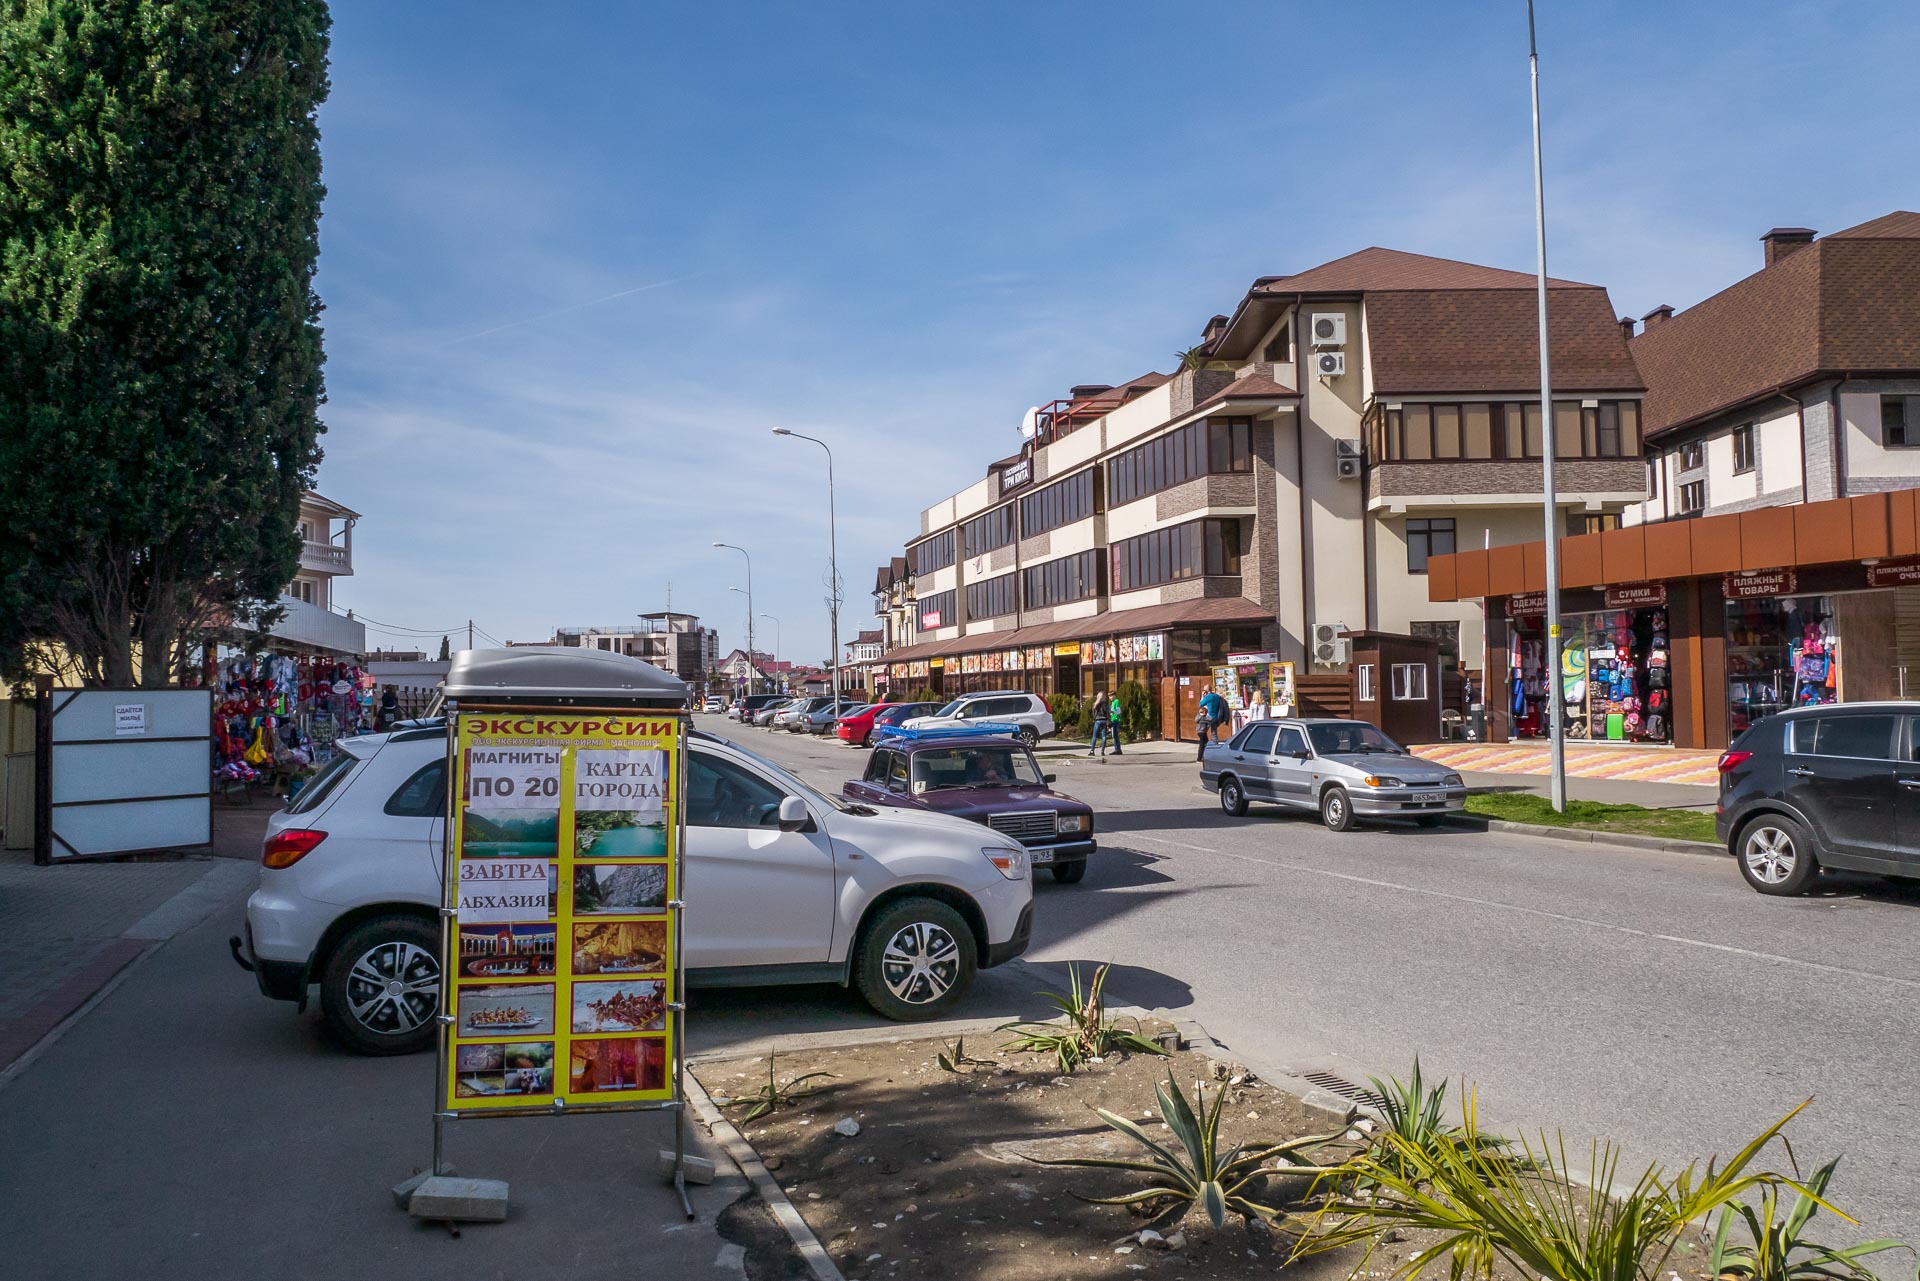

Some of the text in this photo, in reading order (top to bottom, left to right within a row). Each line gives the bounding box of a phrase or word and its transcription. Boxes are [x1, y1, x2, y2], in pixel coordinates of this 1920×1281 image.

[1004, 469, 1028, 488] ТРИ КИТА
[1876, 565, 1915, 575] ПЛЯЖНЫЕ
[1733, 574, 1784, 587] ПЛЯЖНЫЕ
[1619, 588, 1650, 599] СУМКИ
[1739, 584, 1779, 596] ТОВАРЫ
[466, 719, 672, 736] ЭКСКУРСИИ
[472, 738, 492, 746] ООО
[495, 738, 571, 746] ЭКСКУРСИОННАЯ
[573, 739, 604, 747] ФИРМА
[472, 752, 560, 764] МАГНИТЫ
[585, 762, 655, 777] КАРТА
[472, 776, 559, 797] ПО 20
[577, 783, 661, 800] ГОРОДА
[460, 863, 547, 880] ЗАВТРА
[459, 895, 547, 909] АБХАЗИЯ
